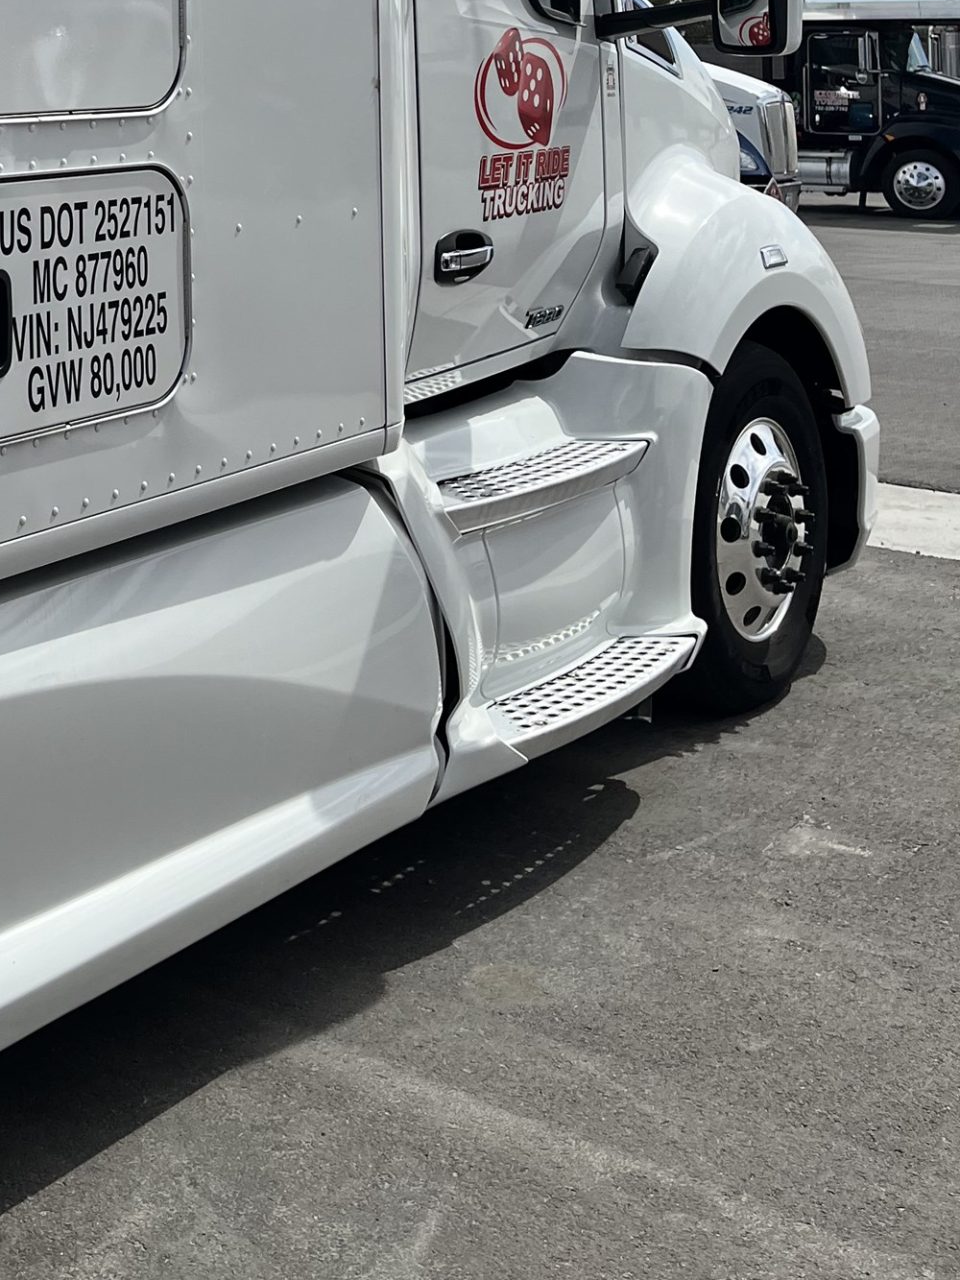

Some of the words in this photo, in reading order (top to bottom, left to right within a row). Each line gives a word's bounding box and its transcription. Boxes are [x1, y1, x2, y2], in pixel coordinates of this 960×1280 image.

[478, 153, 514, 191] LET
[515, 150, 534, 185] IT
[535, 145, 571, 183] RIDE
[0, 207, 32, 256] US
[40, 201, 88, 250] DOT
[94, 192, 175, 242] 2527151
[481, 178, 566, 222] TRUCKING
[33, 256, 68, 305] MC
[75, 245, 149, 298] 877960
[12, 311, 59, 362] VIN:
[67, 291, 168, 352] NJ479225
[28, 357, 83, 413] GVW
[90, 343, 157, 402] 80,000
